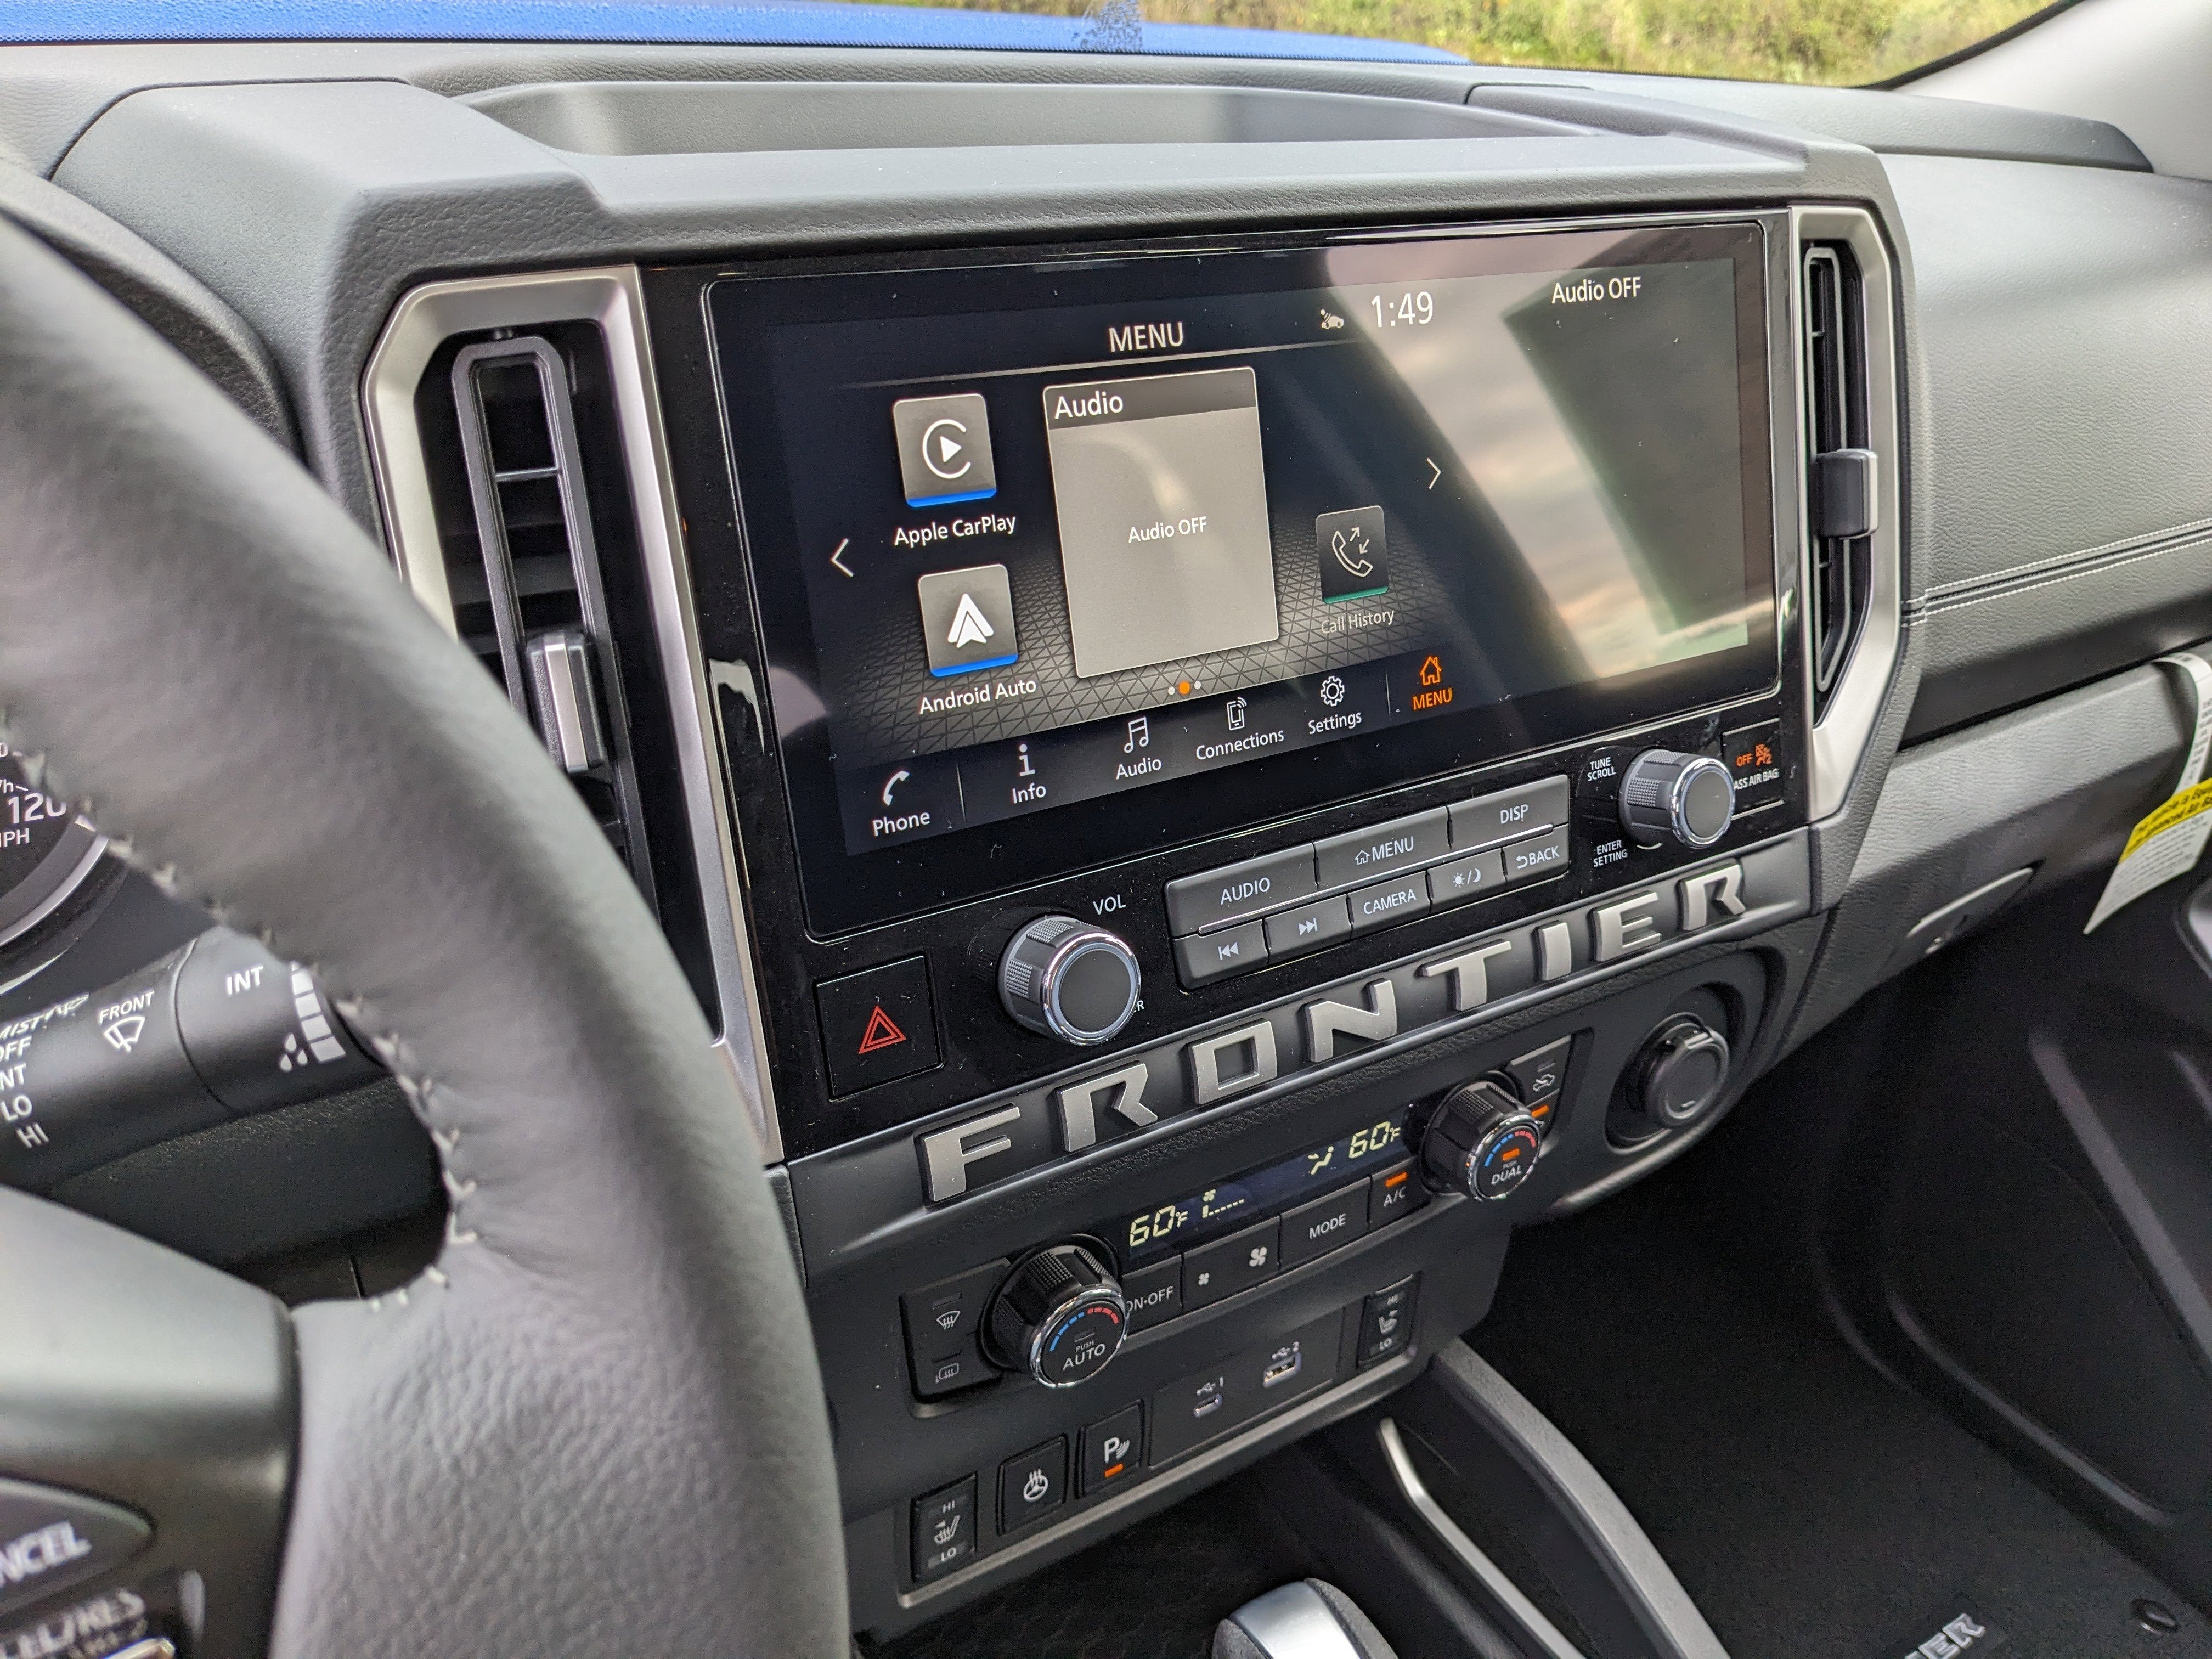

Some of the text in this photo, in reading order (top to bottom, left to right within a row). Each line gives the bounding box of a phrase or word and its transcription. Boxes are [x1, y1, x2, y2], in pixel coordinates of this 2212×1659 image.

[1551, 276, 1642, 304] Audio OFF
[1370, 291, 1434, 328] 1:49
[1108, 321, 1185, 353] MENU
[1054, 391, 1124, 420] Audio
[894, 514, 1017, 548] Apple CarPlay
[1127, 515, 1209, 544] Audio OFF
[1321, 607, 1395, 635] Call History
[919, 679, 1037, 715] Android Auto
[1412, 687, 1453, 711] MENU
[1308, 710, 1362, 736] Settings
[1195, 727, 1284, 761] Connections
[1115, 757, 1163, 780] Audio
[1589, 757, 1612, 771] TUNE
[1736, 753, 1753, 767] OFF
[1587, 766, 1617, 782] SCROLL
[1733, 768, 1780, 791] ASS AIR BAG
[1012, 783, 1047, 805] Info
[872, 811, 931, 837] Phone
[1500, 804, 1529, 825] DISP
[0, 828, 30, 848] PH
[1372, 836, 1415, 862] MENU
[1596, 839, 1622, 855] ENTER
[1528, 845, 1560, 866] BACK
[1593, 849, 1628, 868] SETTING
[1220, 877, 1271, 905] AUDIO
[1363, 889, 1417, 915] CAMERA
[1092, 894, 1127, 916] VOL
[226, 966, 264, 996] INT
[98, 991, 155, 1025] FRONT
[924, 864, 1747, 1203] FRONTIER
[0, 1063, 27, 1091] NT
[1, 1094, 33, 1122] LO
[16, 1122, 50, 1149] HI
[1491, 1164, 1522, 1186] DUAL
[1383, 1186, 1406, 1207] A/C
[1309, 1213, 1346, 1240] MODE
[1062, 1343, 1106, 1371] AUTO
[1075, 1340, 1095, 1352] PUSH
[942, 1500, 956, 1514] HI
[0, 1520, 92, 1587] NCEL
[940, 1547, 957, 1562] LO
